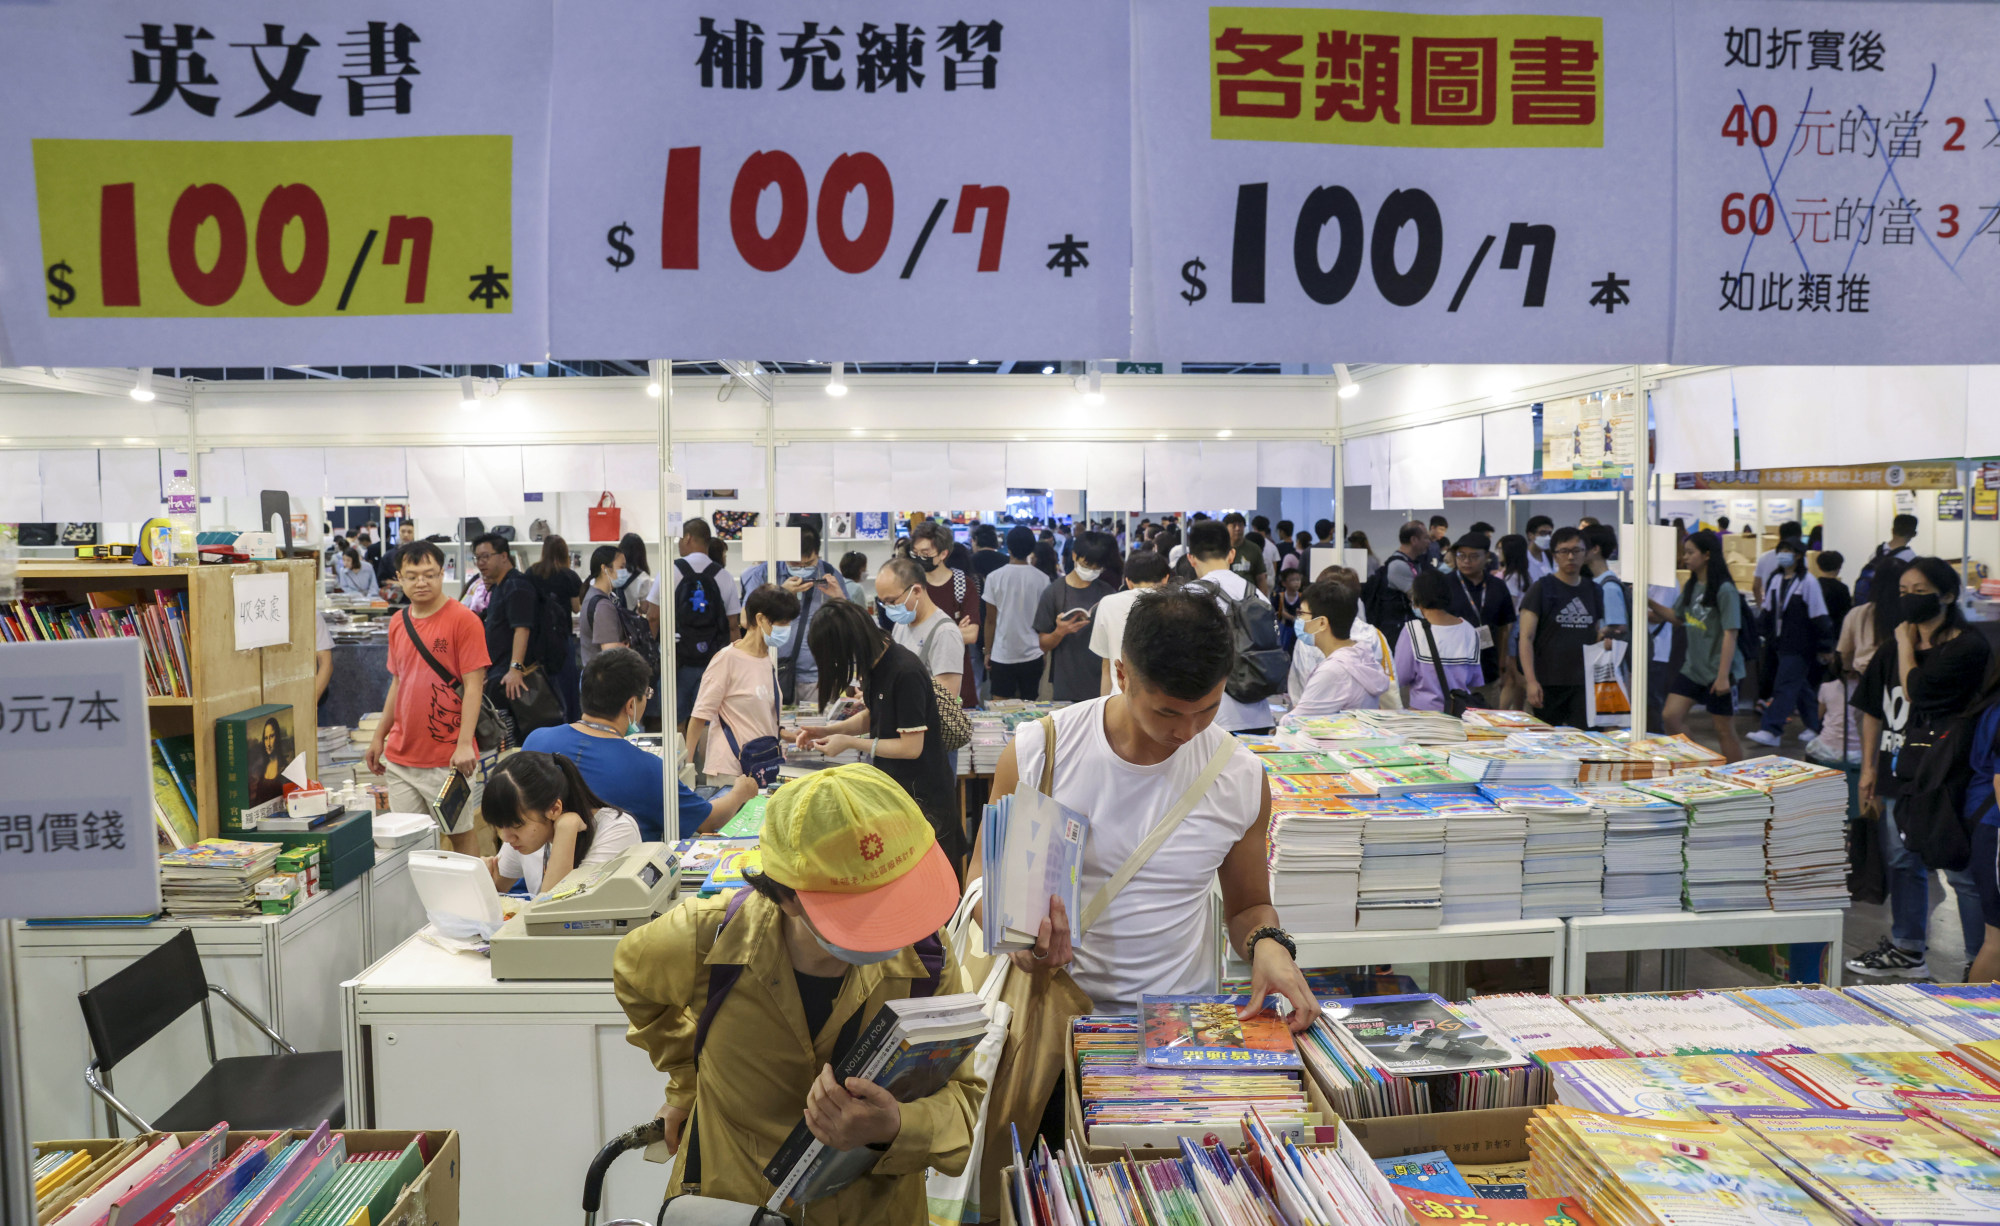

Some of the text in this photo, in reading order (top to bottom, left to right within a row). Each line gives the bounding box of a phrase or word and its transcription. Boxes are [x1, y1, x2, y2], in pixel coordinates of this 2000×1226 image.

[123, 20, 422, 118] 英文書
[693, 16, 1004, 93] 補充練習
[1724, 26, 1886, 72] 如折實後
[1214, 27, 1600, 126] 各類圖書
[1718, 270, 1871, 313] 如此類推
[1555, 613, 1594, 625] adidas
[432, 637, 449, 653] 熱
[0, 689, 120, 733] 元7本
[869, 1019, 887, 1040] POLY
[844, 1038, 873, 1075] AUCTION
